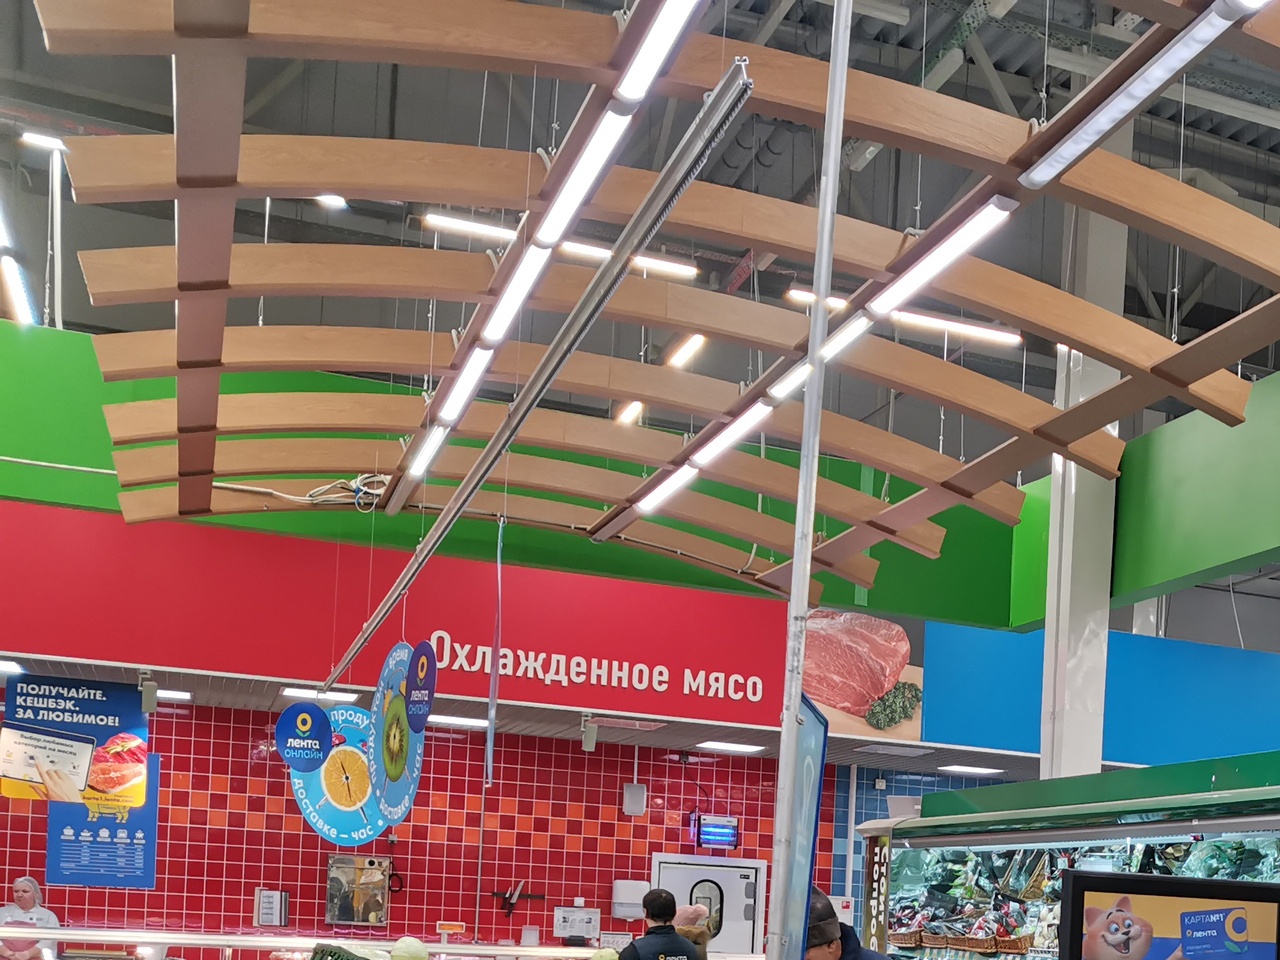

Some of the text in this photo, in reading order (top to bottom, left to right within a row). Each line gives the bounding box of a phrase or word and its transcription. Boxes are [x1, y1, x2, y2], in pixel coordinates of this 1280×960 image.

[430, 629, 763, 702] Охлажденное мясо
[17, 683, 107, 700] ПОЛУЧАЙТЕ.
[410, 690, 429, 701] лента
[16, 696, 80, 711] КЕШБЭК.
[408, 702, 430, 715] онлайн
[15, 708, 119, 726] ЗА ЛЮБИМОЕ!
[330, 710, 370, 728] проду
[287, 738, 320, 749] лента
[285, 748, 323, 760] онлайн
[293, 778, 374, 840] доставке час
[879, 845, 889, 925] Стоит
[1193, 929, 1217, 938] лента
